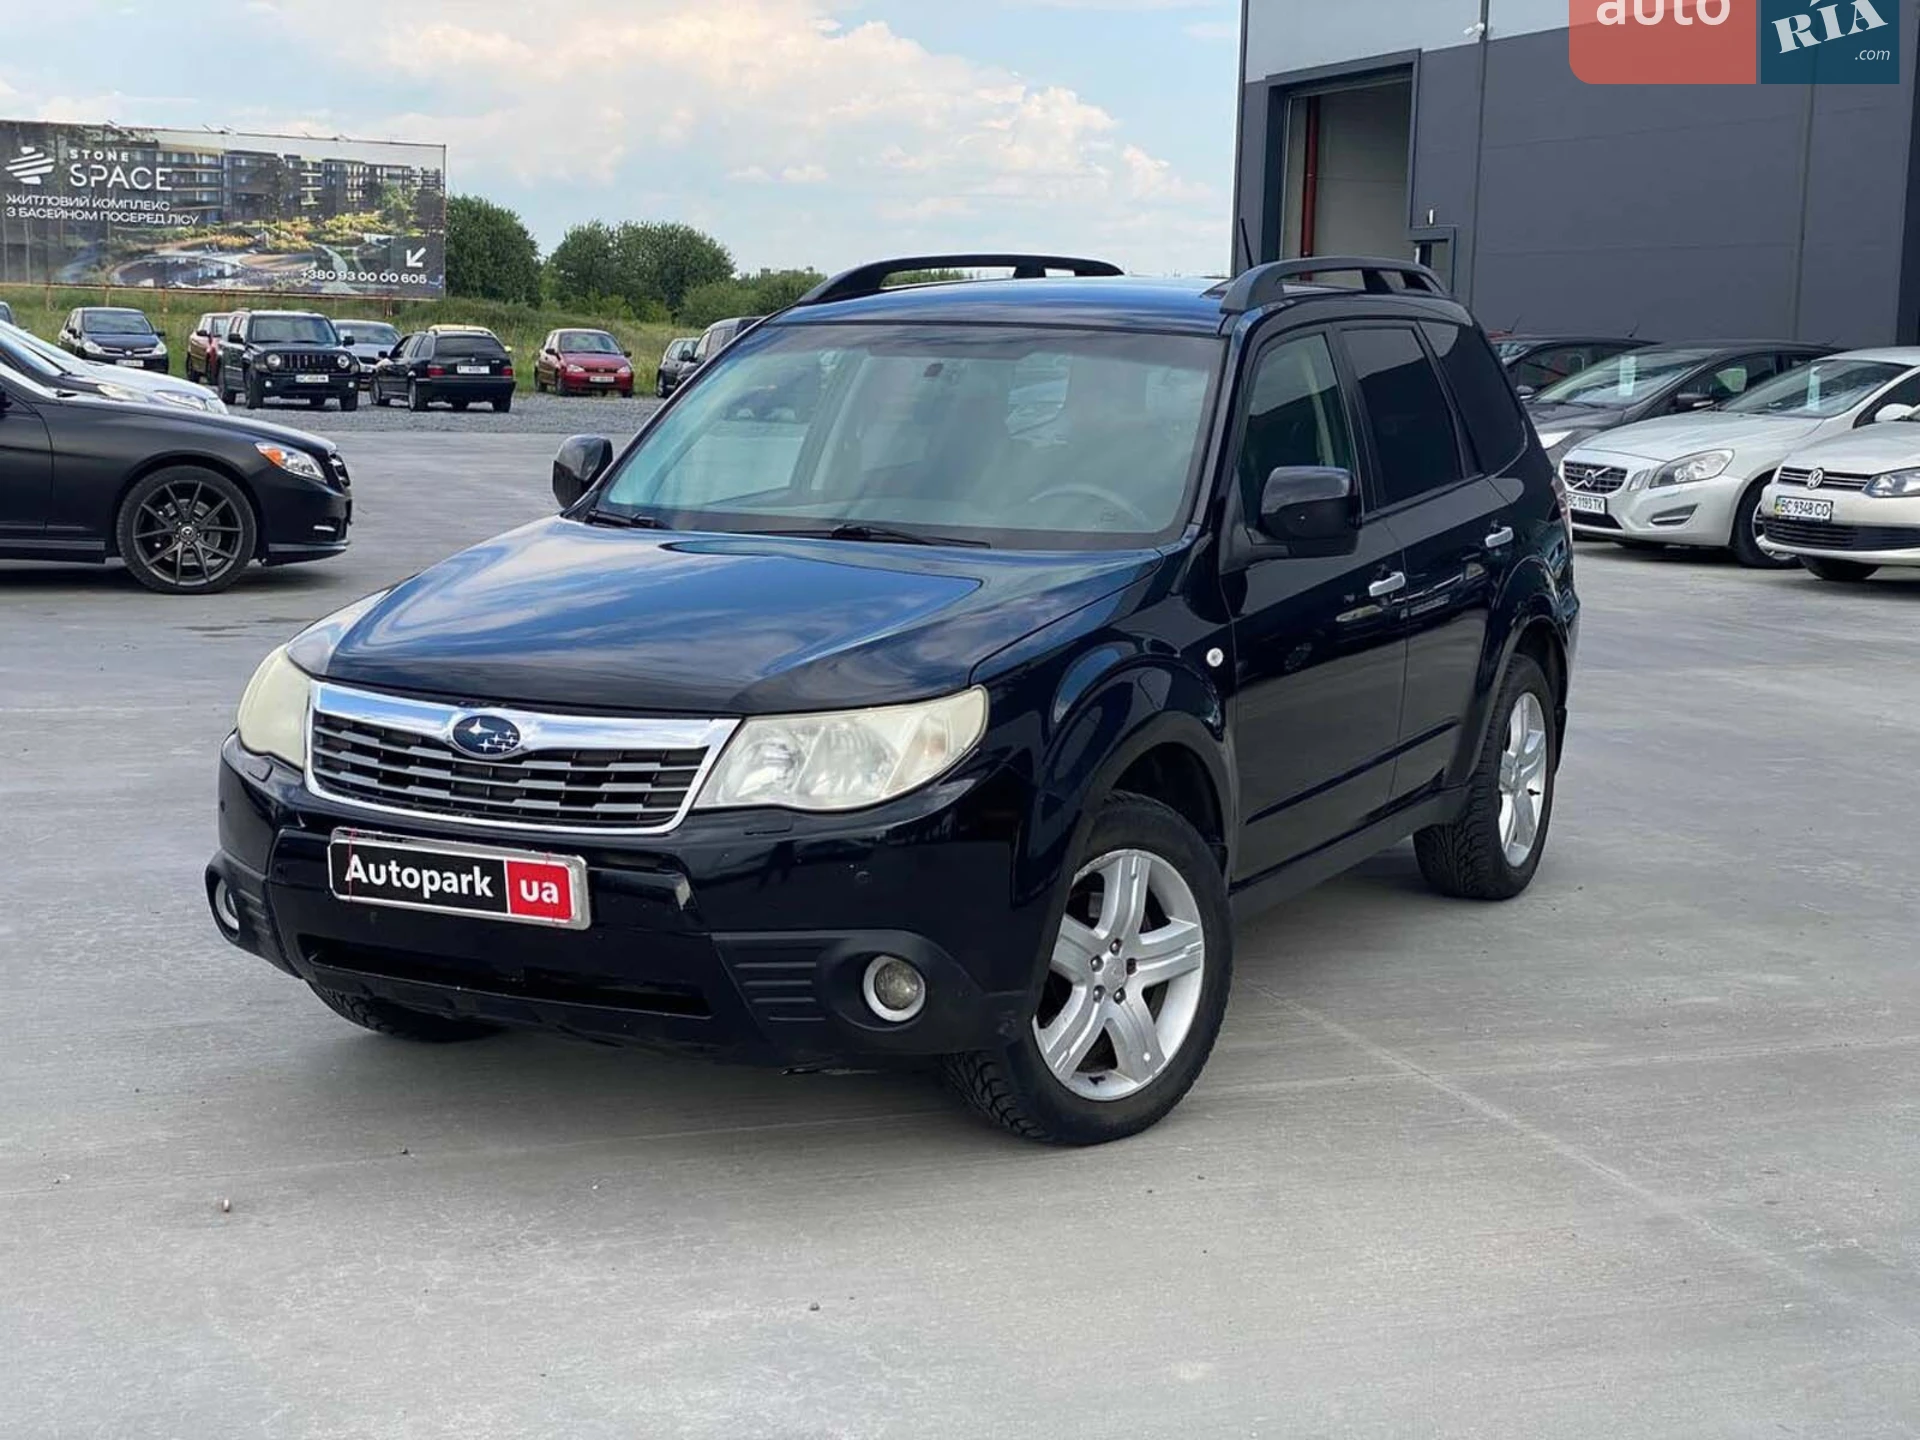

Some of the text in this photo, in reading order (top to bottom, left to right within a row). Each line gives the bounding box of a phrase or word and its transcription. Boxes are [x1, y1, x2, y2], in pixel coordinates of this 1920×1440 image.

[70, 149, 129, 162] STONE
[70, 163, 172, 190] SPACE
[6, 194, 170, 211] ЖИТЛОВИЙ КОМПЛЕКС
[18, 208, 98, 221] БАСЕЙНОМ
[100, 212, 165, 224] ПОСЕРЕД
[167, 214, 199, 225] ЛІСУ
[301, 269, 336, 280] +380
[337, 270, 356, 281] 93
[357, 272, 377, 282] 00
[379, 273, 399, 282] 00
[344, 853, 560, 905] Autopark ua
